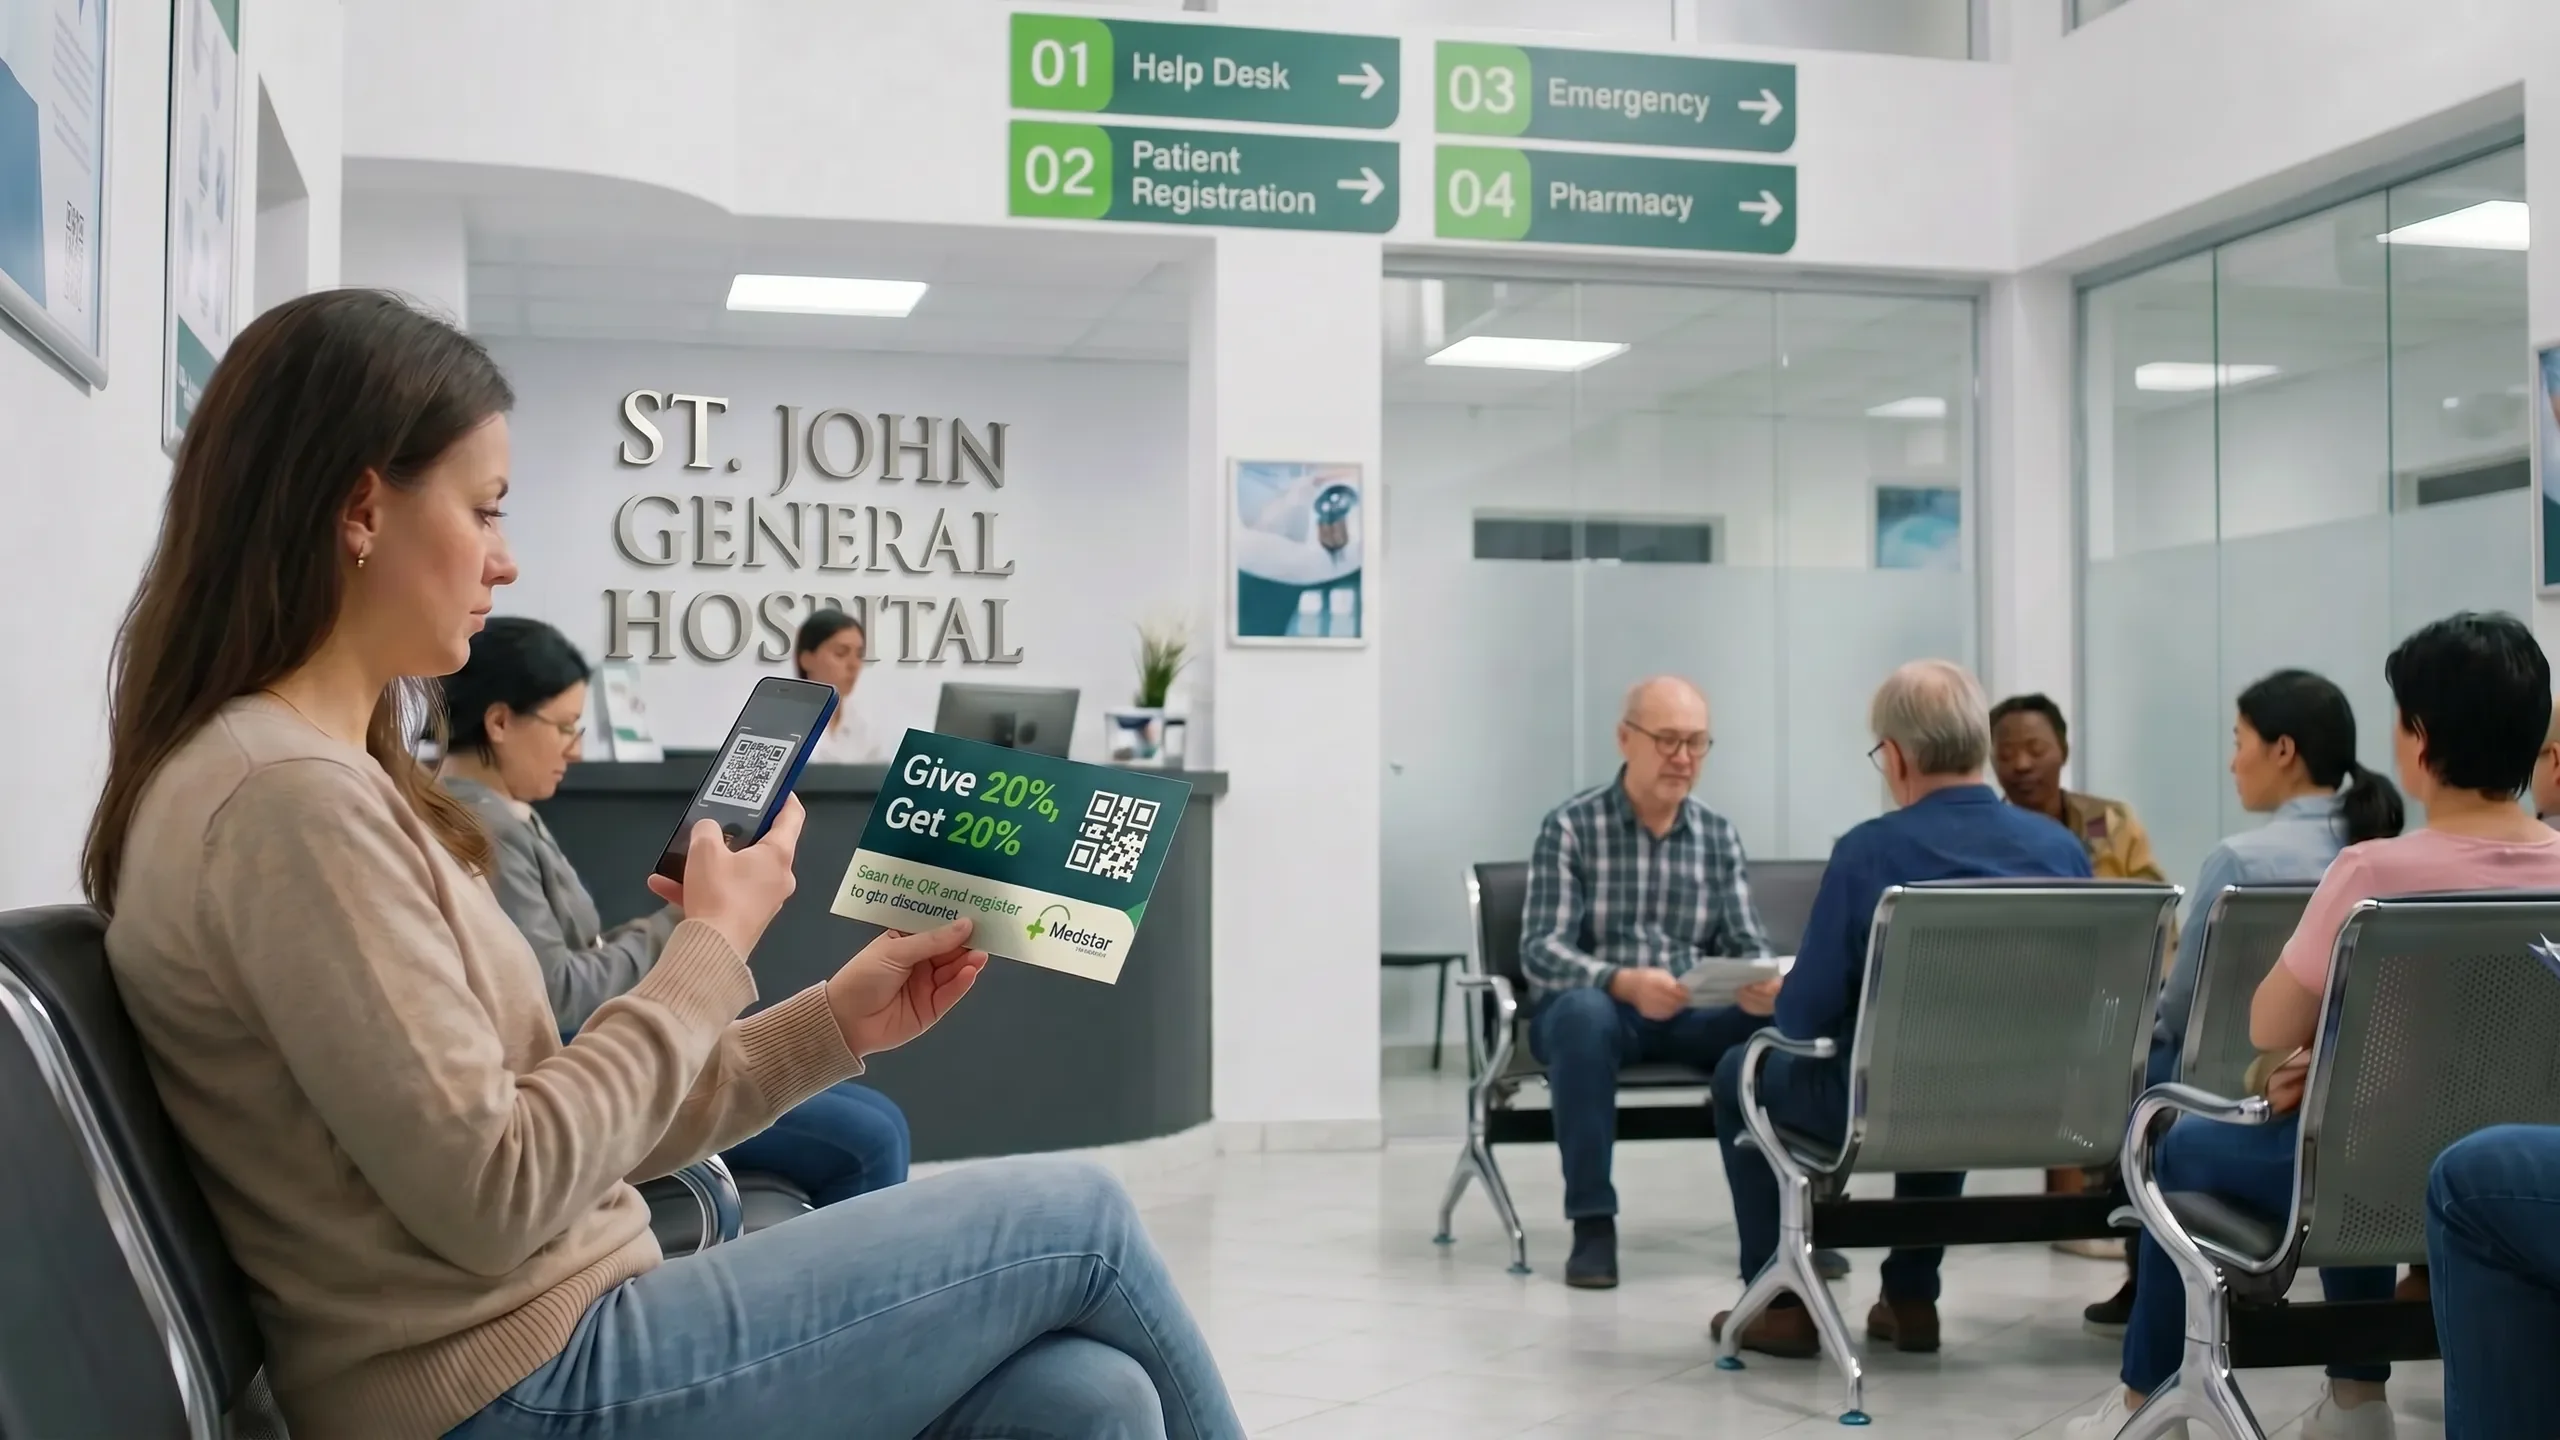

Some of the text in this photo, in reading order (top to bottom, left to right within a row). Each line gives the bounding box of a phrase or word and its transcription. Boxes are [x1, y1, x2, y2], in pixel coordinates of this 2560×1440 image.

[1031, 38, 1291, 92] 01 Help Desk
[1448, 64, 1711, 123] 03 Emergency
[1024, 145, 1095, 196] 02
[1132, 139, 1242, 176] Patient
[1132, 176, 1316, 216] Registration
[1448, 168, 1694, 223] 04 Pharmacy
[618, 388, 1011, 497] ST. JOHN
[611, 493, 1016, 577] GENERAL
[903, 753, 1060, 823] Give 20%,
[885, 796, 1022, 856] Get 20%
[850, 883, 865, 898] to
[892, 873, 914, 890] the
[940, 888, 969, 903] and
[969, 894, 1023, 916] register
[1049, 921, 1113, 951] Medstar
